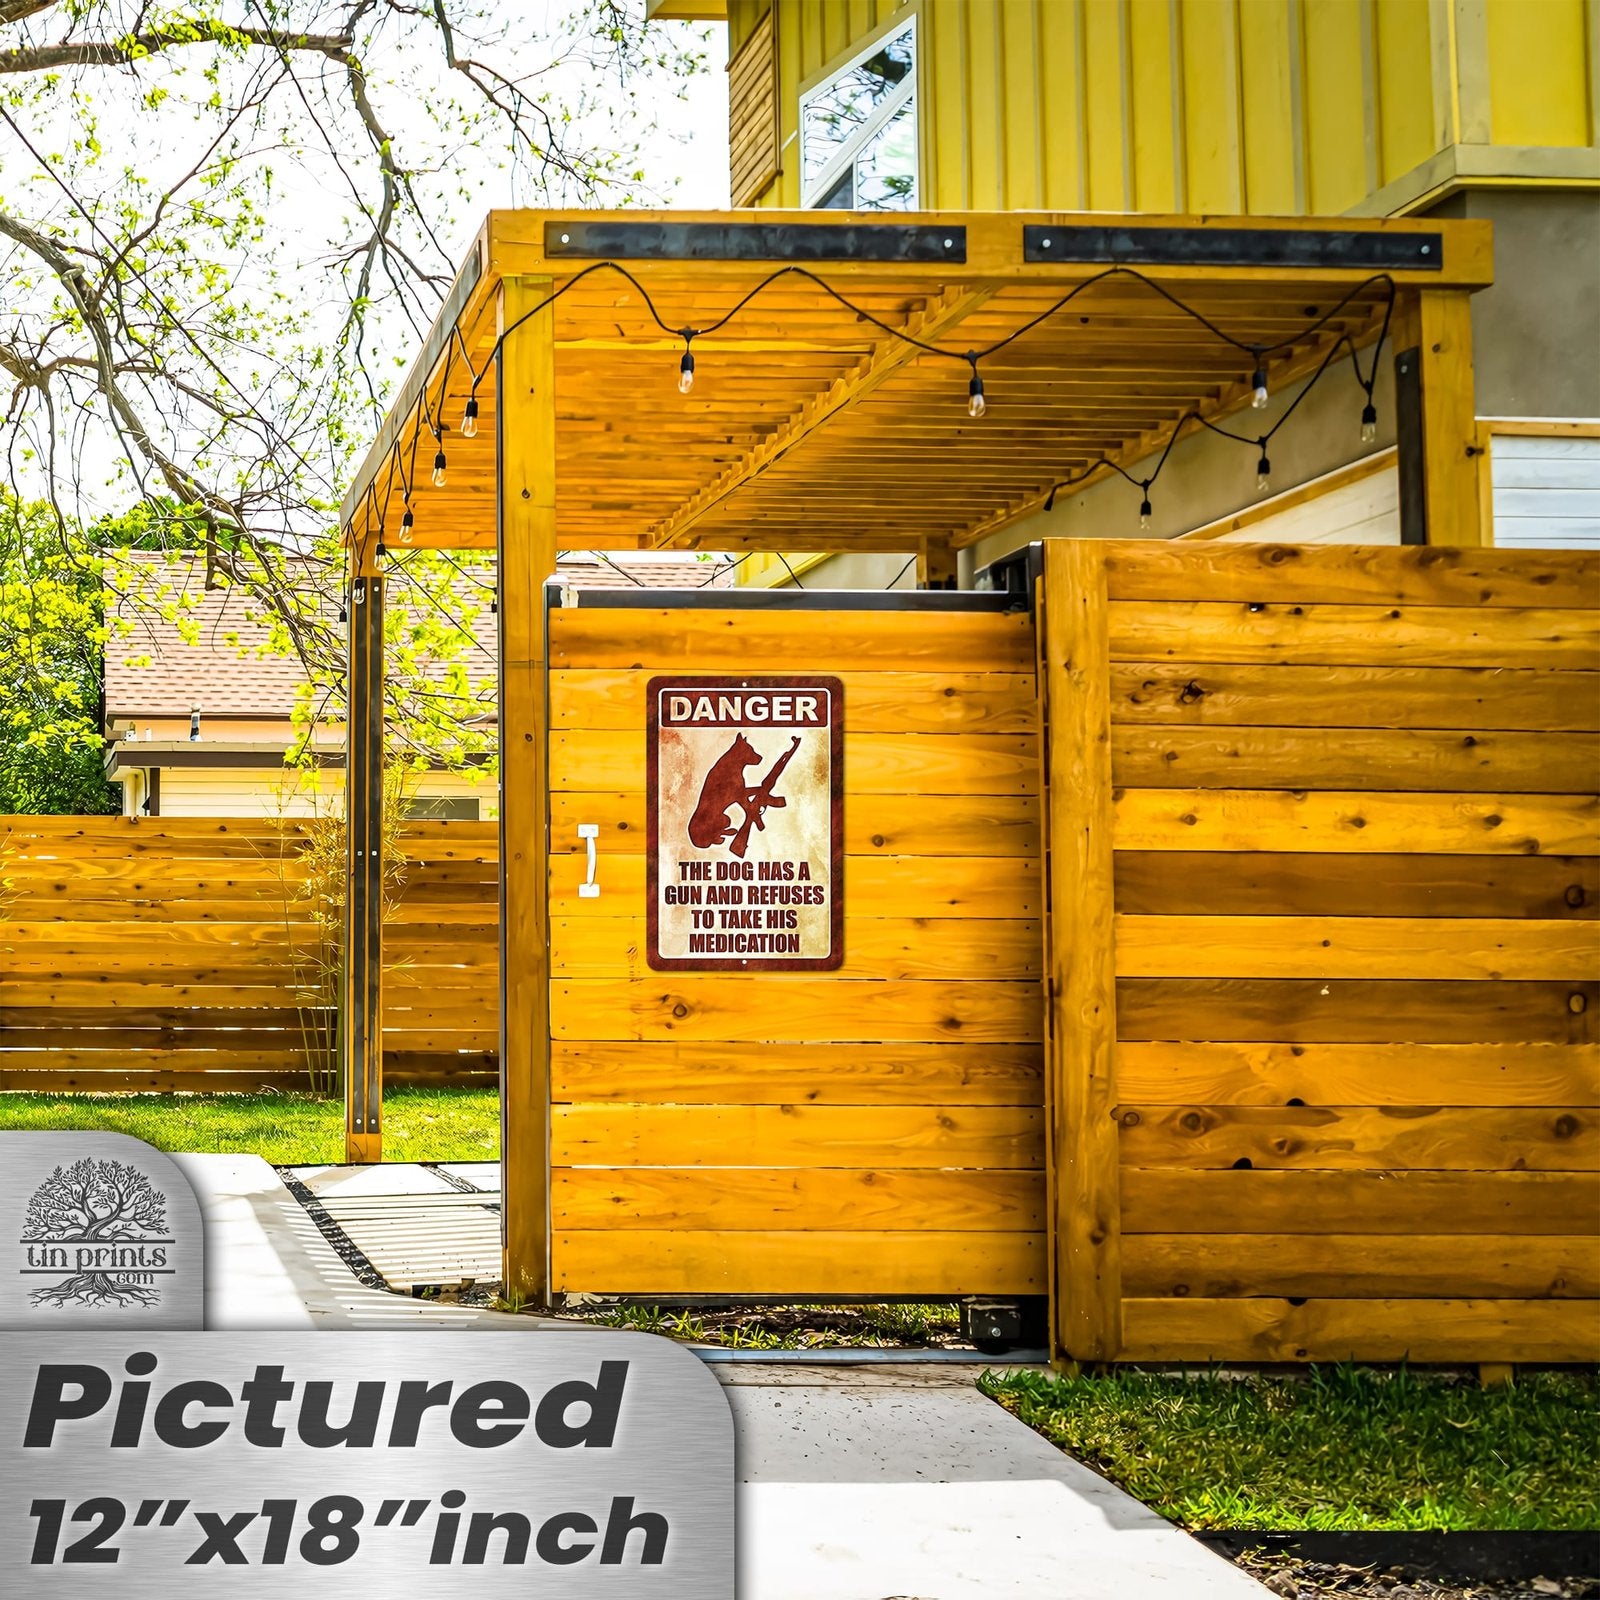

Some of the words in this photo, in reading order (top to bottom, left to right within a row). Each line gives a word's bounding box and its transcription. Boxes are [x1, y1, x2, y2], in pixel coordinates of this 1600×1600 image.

[669, 696, 818, 722] DANGER
[678, 861, 711, 881] THE
[716, 861, 754, 881] DOG
[758, 861, 795, 881] HAS
[797, 861, 810, 881] A
[664, 885, 703, 905] GUN
[705, 885, 743, 905] AND
[747, 885, 825, 905] REFUSES
[691, 909, 714, 929] TO
[718, 909, 763, 929] TAKE
[766, 909, 798, 929] HIS
[689, 933, 800, 953] MEDICATION
